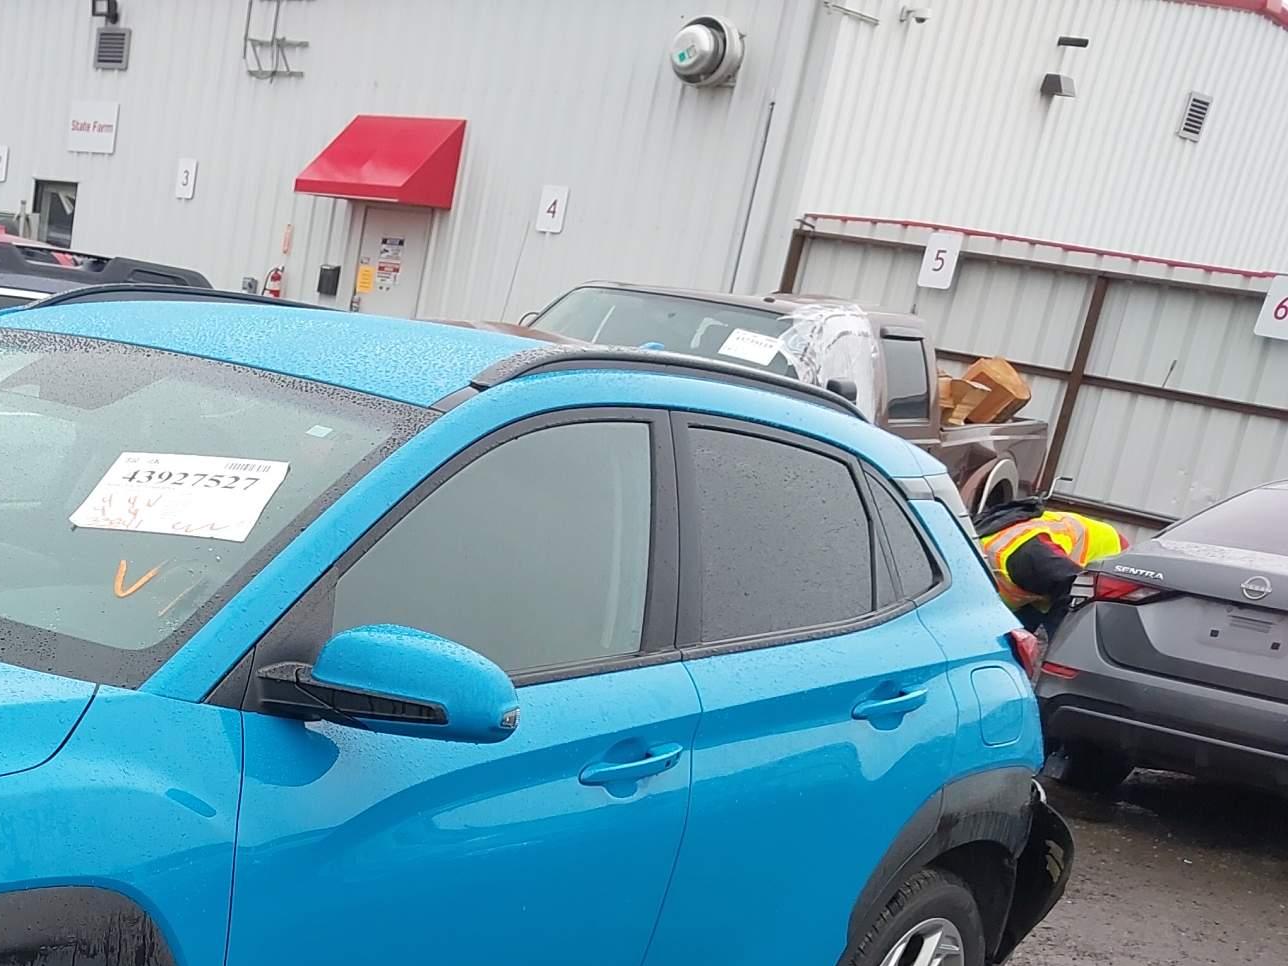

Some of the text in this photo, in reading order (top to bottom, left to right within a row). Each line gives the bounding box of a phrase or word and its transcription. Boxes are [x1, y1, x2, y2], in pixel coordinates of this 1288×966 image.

[71, 119, 91, 132] State
[182, 169, 190, 186] 3
[546, 199, 558, 218] 4
[931, 249, 947, 272] 5
[1273, 296, 1288, 321] 6
[122, 468, 260, 491] 43927527
[1114, 564, 1164, 581] SENTRA
